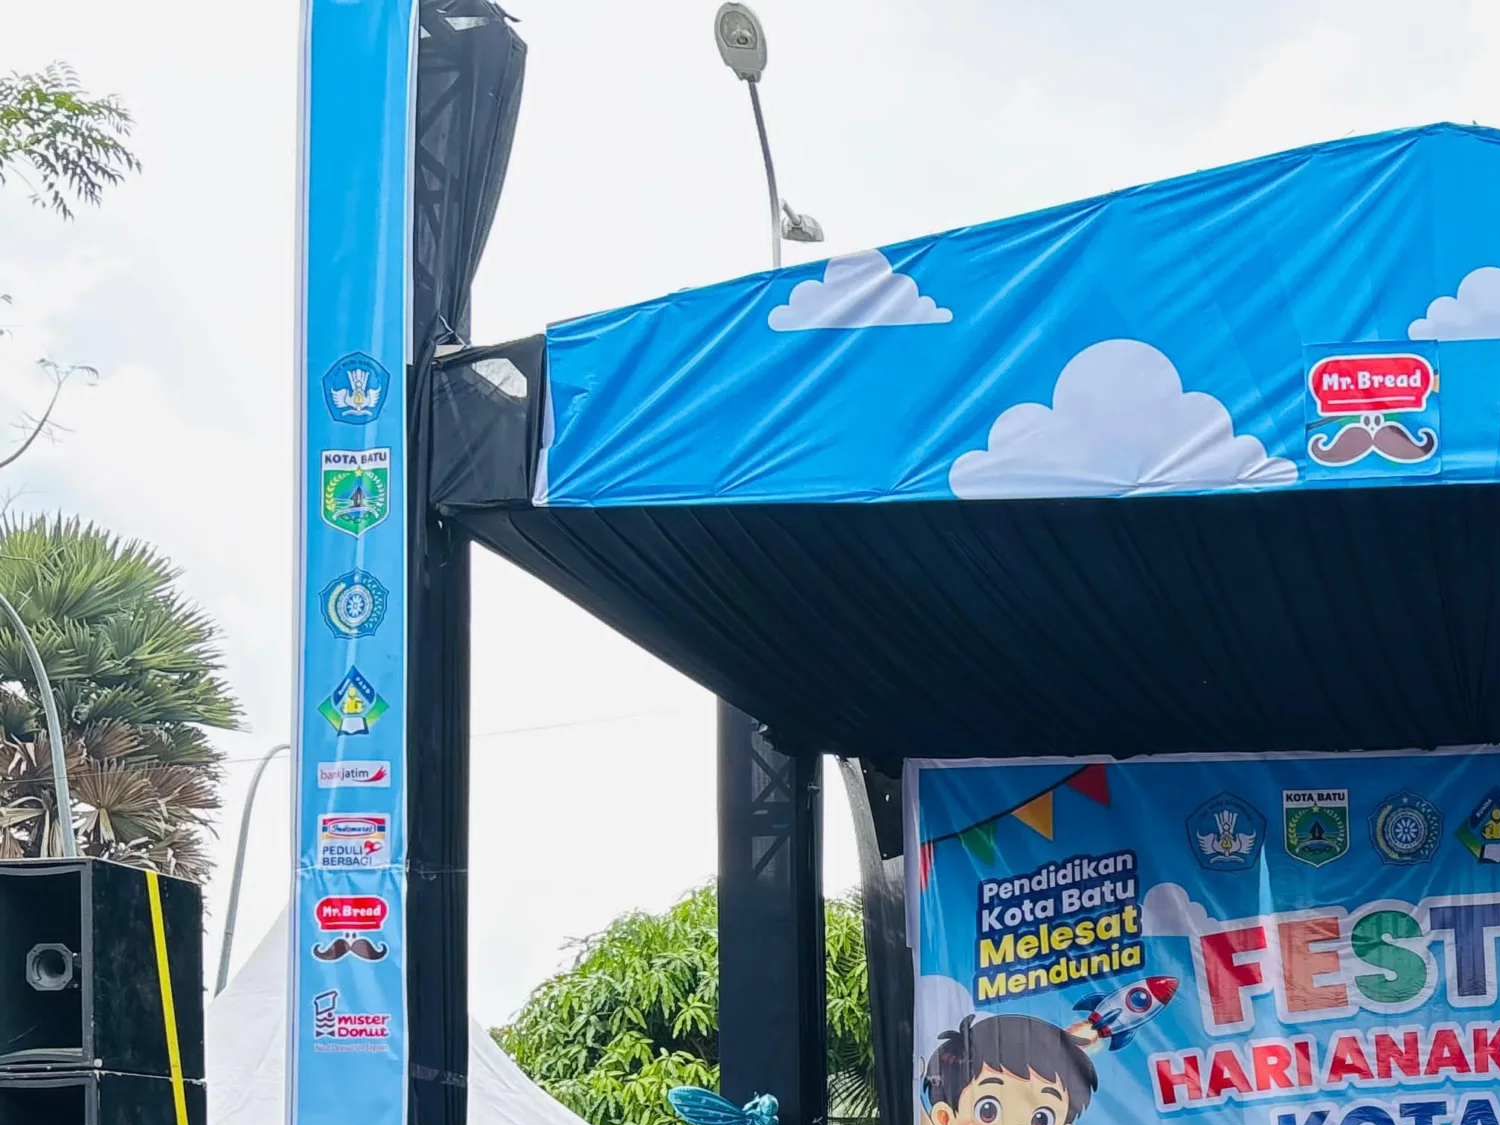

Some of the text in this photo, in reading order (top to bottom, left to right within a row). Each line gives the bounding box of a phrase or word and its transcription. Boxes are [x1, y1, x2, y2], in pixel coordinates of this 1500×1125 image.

[1322, 369, 1422, 391] Mr. Bread
[324, 451, 387, 465] KOTA BATU
[1285, 792, 1345, 802] KOTA BATU
[322, 846, 363, 856] PEDULI
[322, 857, 372, 866] BERBAGI
[982, 853, 1133, 904] Pendidikan
[323, 905, 381, 917] Mr. Bread
[982, 878, 1135, 932] Kota Batu
[979, 905, 1138, 968] Melesat
[978, 943, 1141, 1001] Mendunia
[337, 1027, 390, 1037] Donut
[1157, 1042, 1310, 1105] HARI
